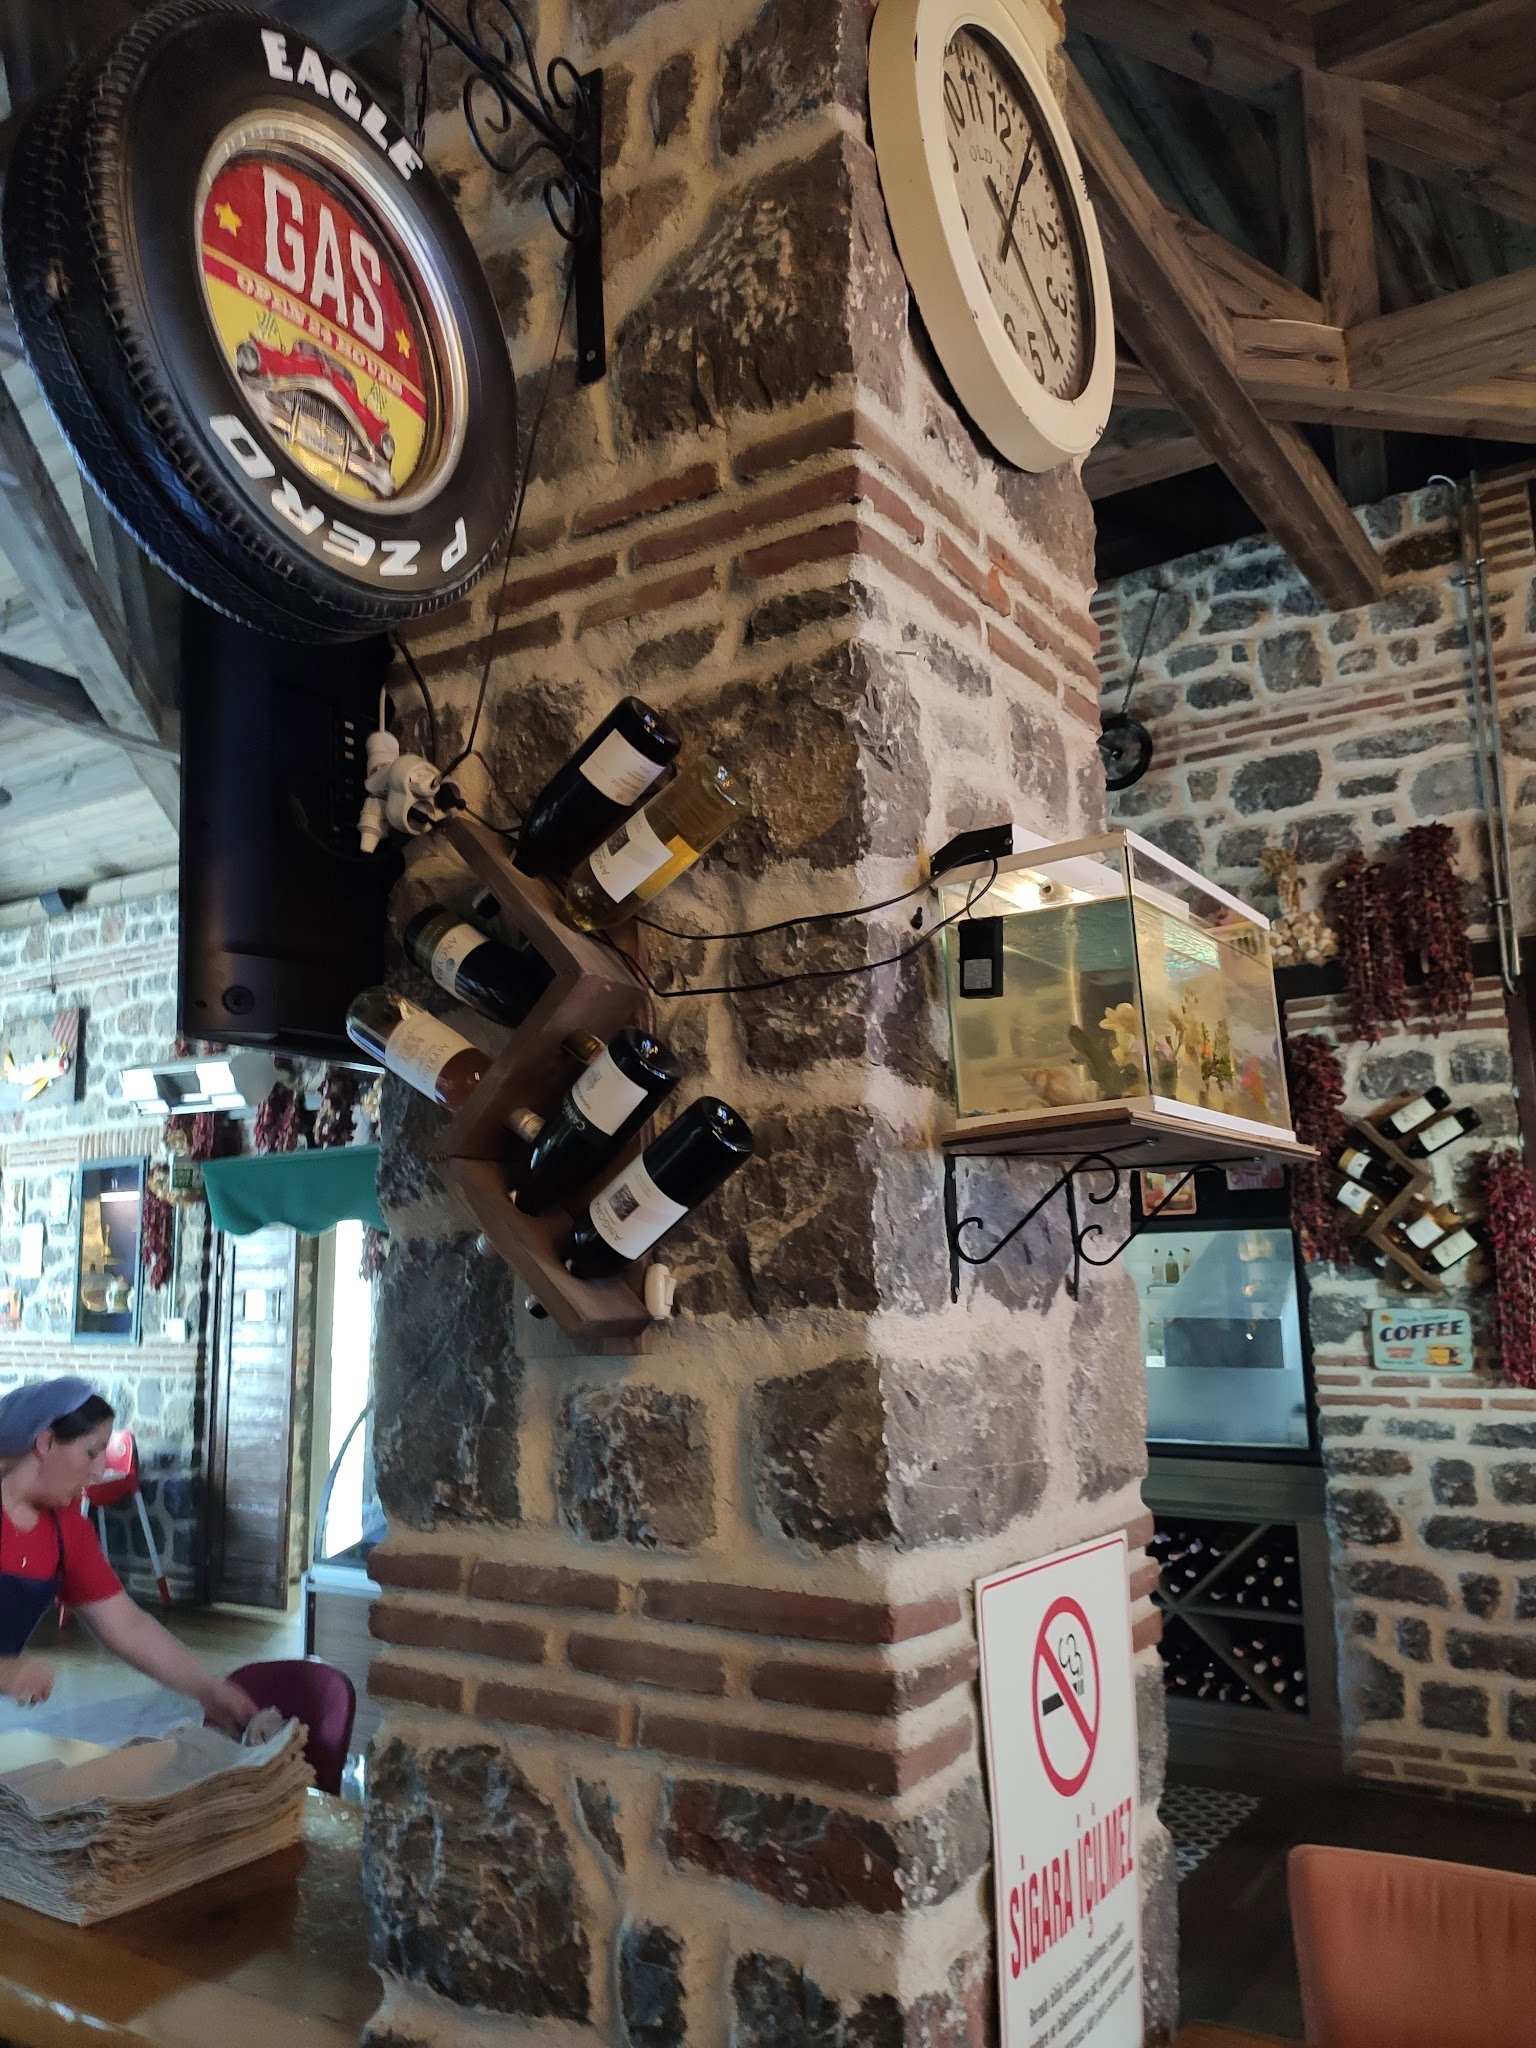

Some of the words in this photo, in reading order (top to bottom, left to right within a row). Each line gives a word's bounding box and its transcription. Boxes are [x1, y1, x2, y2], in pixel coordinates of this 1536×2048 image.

[260, 28, 424, 181] EAGLE
[986, 90, 1012, 158] 12
[969, 143, 993, 165] OLD
[262, 165, 385, 351] GAS
[1044, 275, 1068, 318] 3
[1026, 330, 1045, 386] 5
[1380, 1320, 1463, 1342] COFFEE
[1010, 1848, 1074, 1979] SİGARA
[1076, 1797, 1133, 1938] İÇİLMEZ
